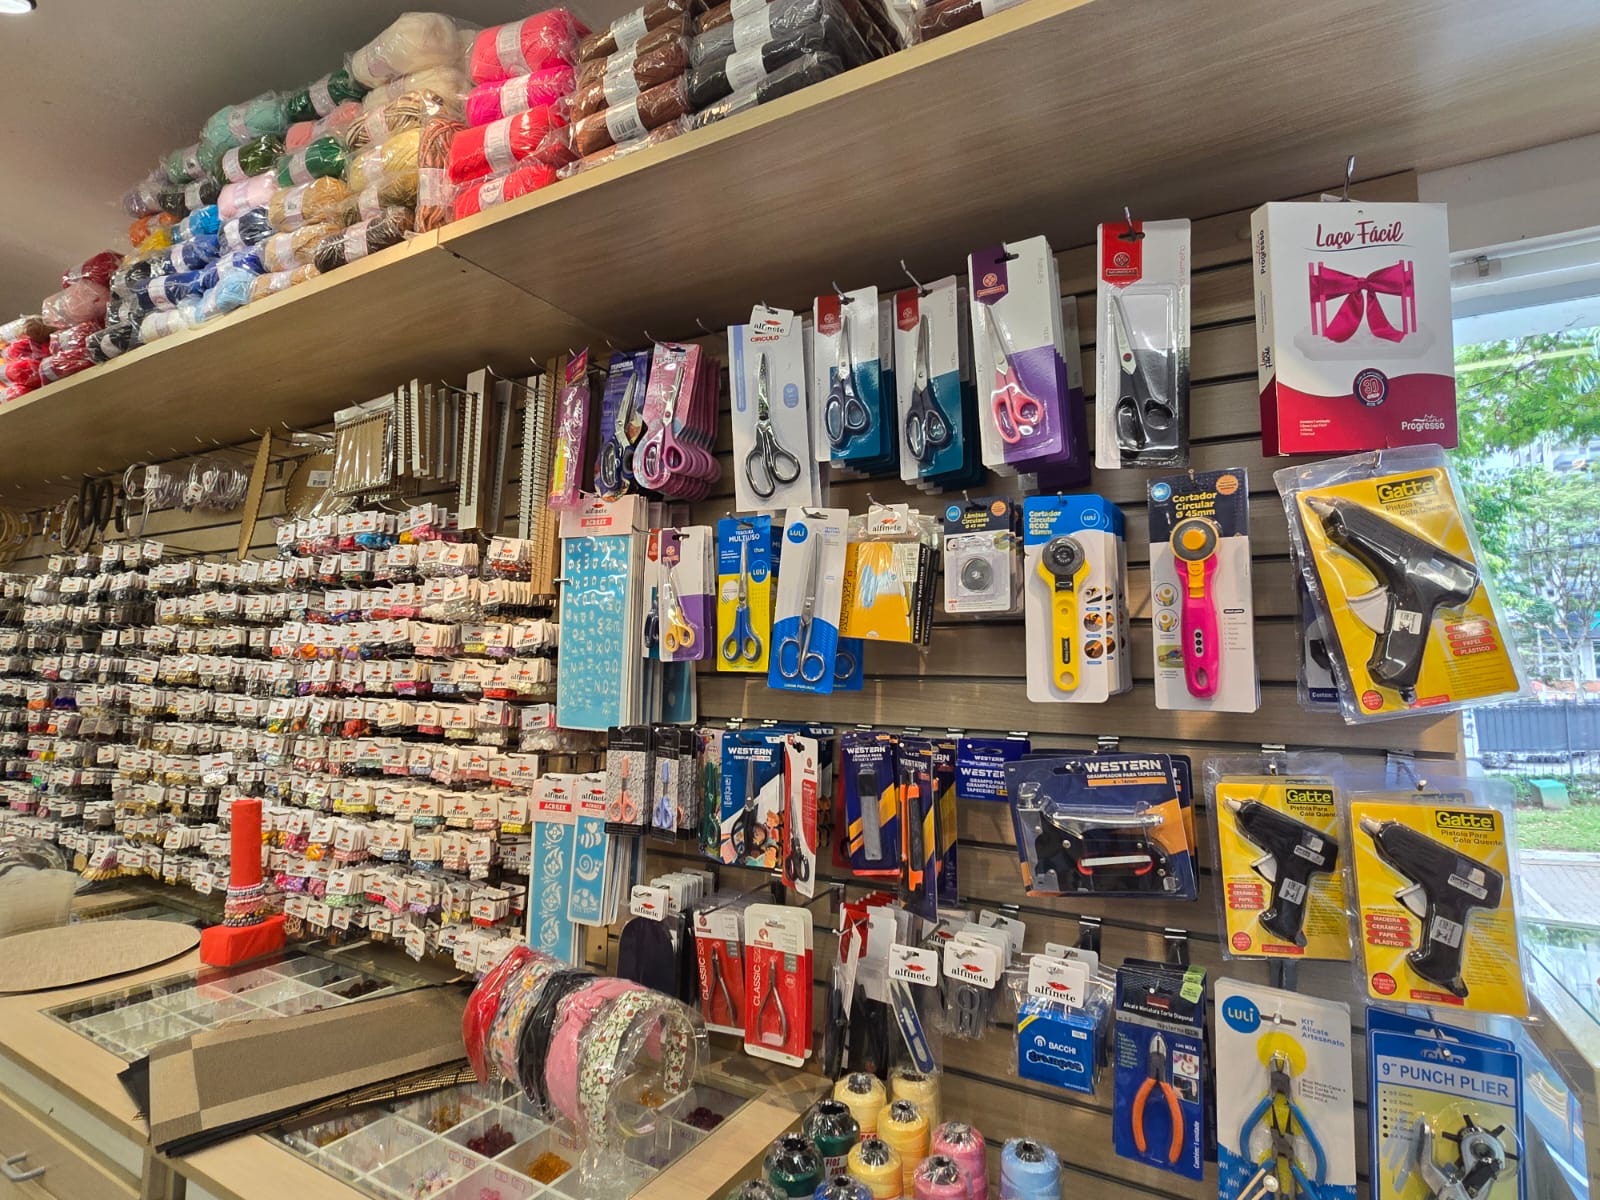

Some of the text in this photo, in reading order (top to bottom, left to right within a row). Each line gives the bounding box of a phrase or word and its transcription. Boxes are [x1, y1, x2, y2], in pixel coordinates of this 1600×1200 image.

[1316, 220, 1403, 249] Laço Fácil
[1401, 421, 1445, 432] Progresso
[1379, 480, 1433, 500] Gatte
[1172, 491, 1217, 503] Cortador
[1175, 500, 1215, 510] Circular
[1185, 508, 1215, 518] 45mm
[872, 523, 901, 532] alfinete
[729, 533, 760, 543] MULTIUSO
[728, 747, 772, 755] WESTERN
[847, 746, 886, 754] WESTERN
[960, 767, 1005, 778] WESTER
[1085, 760, 1161, 773] WESTERN
[544, 792, 568, 800] alfinete
[1287, 790, 1331, 803] Gatte
[1437, 812, 1491, 828] Gatte
[698, 957, 709, 1000] CLASSIC
[894, 969, 931, 982] alfinete
[951, 968, 989, 984] alfinete
[1034, 985, 1076, 1003] alfinete
[1123, 1002, 1139, 1010] Alicate
[1139, 1005, 1160, 1015] Miniatura
[1301, 1018, 1314, 1026] KIT
[1302, 1025, 1328, 1037] Alicate
[1302, 1032, 1345, 1047] Artesanato
[1048, 1041, 1076, 1055] BACCHI
[1400, 1065, 1455, 1087] PUNCH
[1460, 1076, 1509, 1097] PLIER
